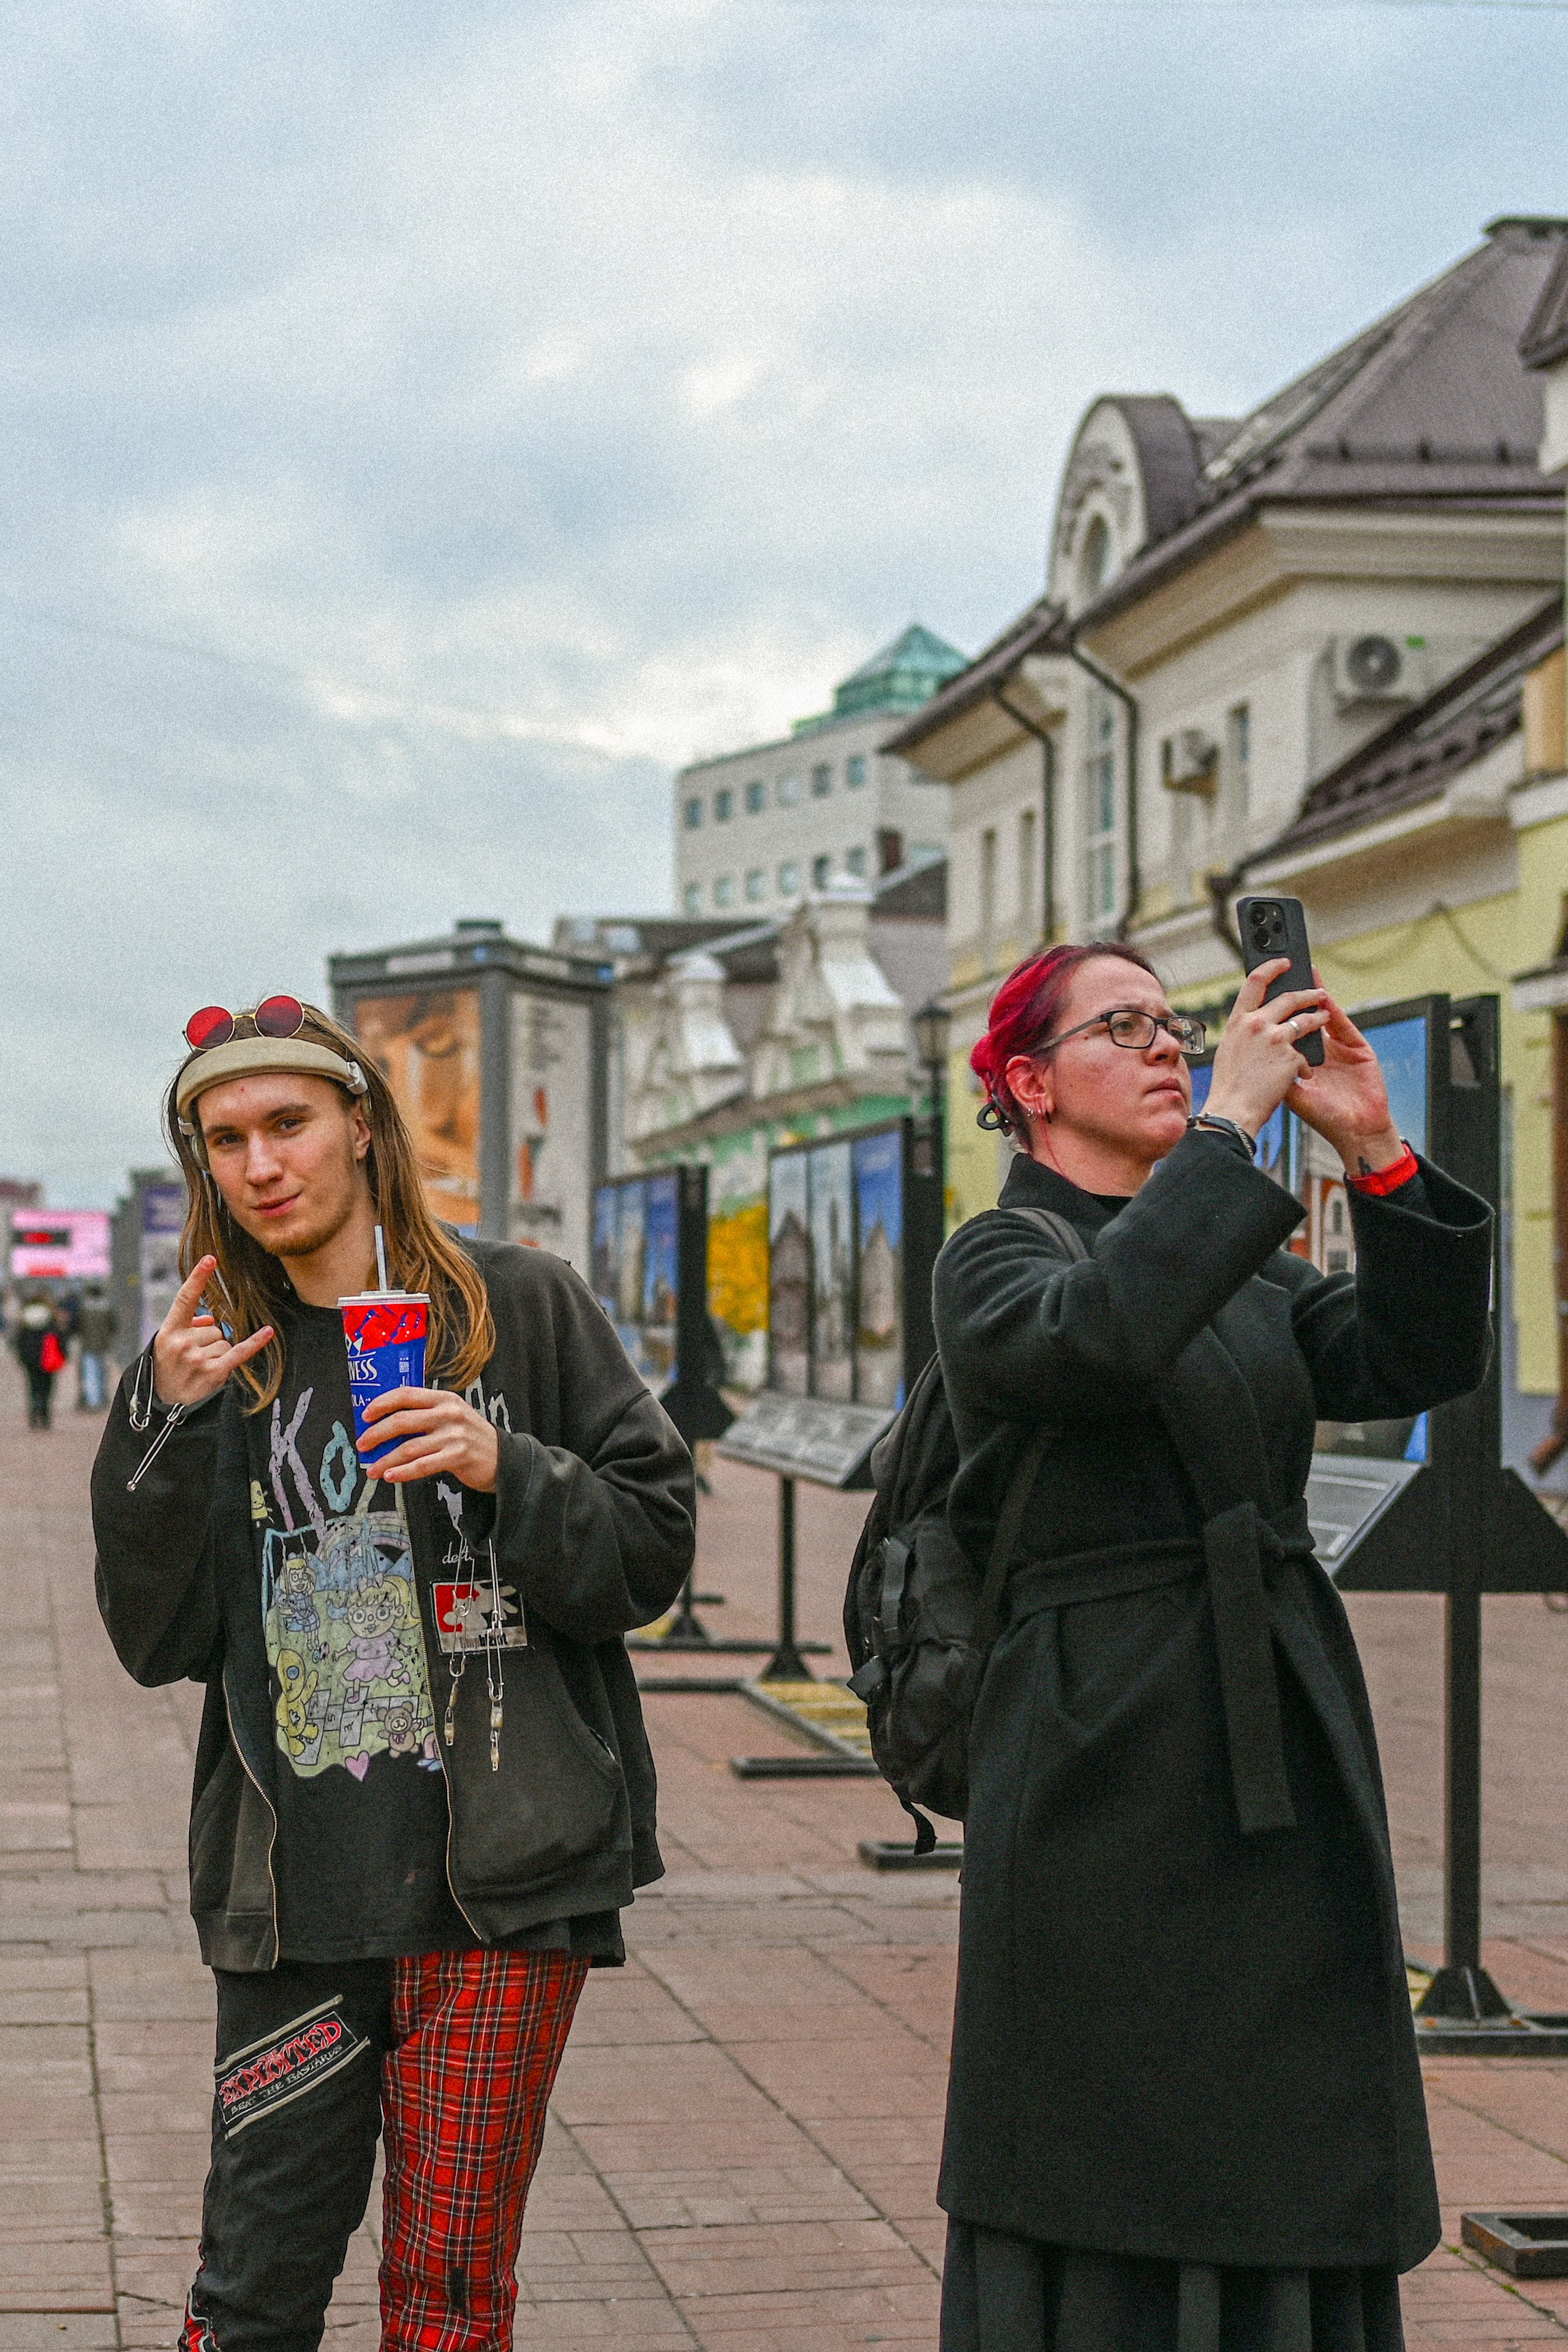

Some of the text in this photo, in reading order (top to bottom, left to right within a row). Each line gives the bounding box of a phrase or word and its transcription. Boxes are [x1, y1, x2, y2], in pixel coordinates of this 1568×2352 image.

[219, 2021, 342, 2109] EXPLOITED
[230, 2045, 343, 2115] BEAT THE BASTARDS
